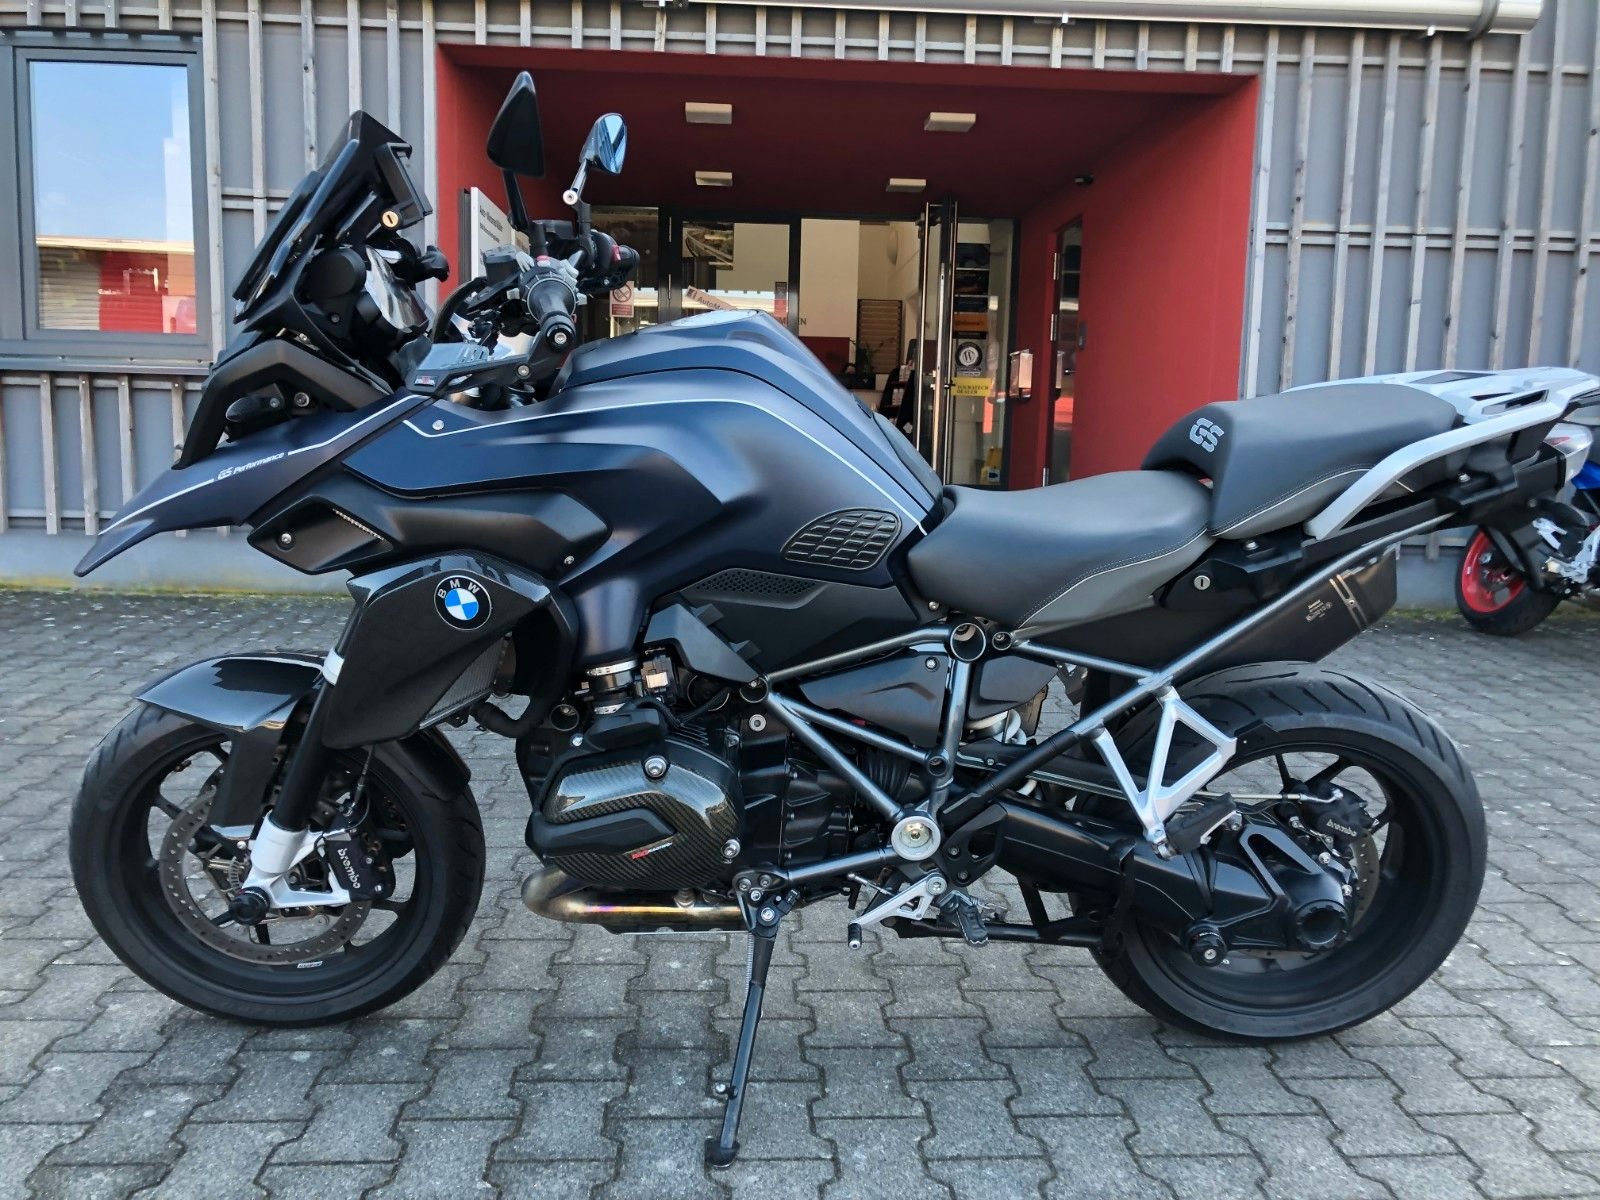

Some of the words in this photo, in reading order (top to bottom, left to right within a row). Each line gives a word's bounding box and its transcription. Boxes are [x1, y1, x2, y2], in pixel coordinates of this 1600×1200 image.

[1190, 418, 1225, 453] GS
[218, 467, 234, 480] GS
[233, 452, 285, 474] Performance
[437, 579, 480, 599] BMW
[1326, 819, 1357, 837] brembo
[337, 848, 361, 889] brembo
